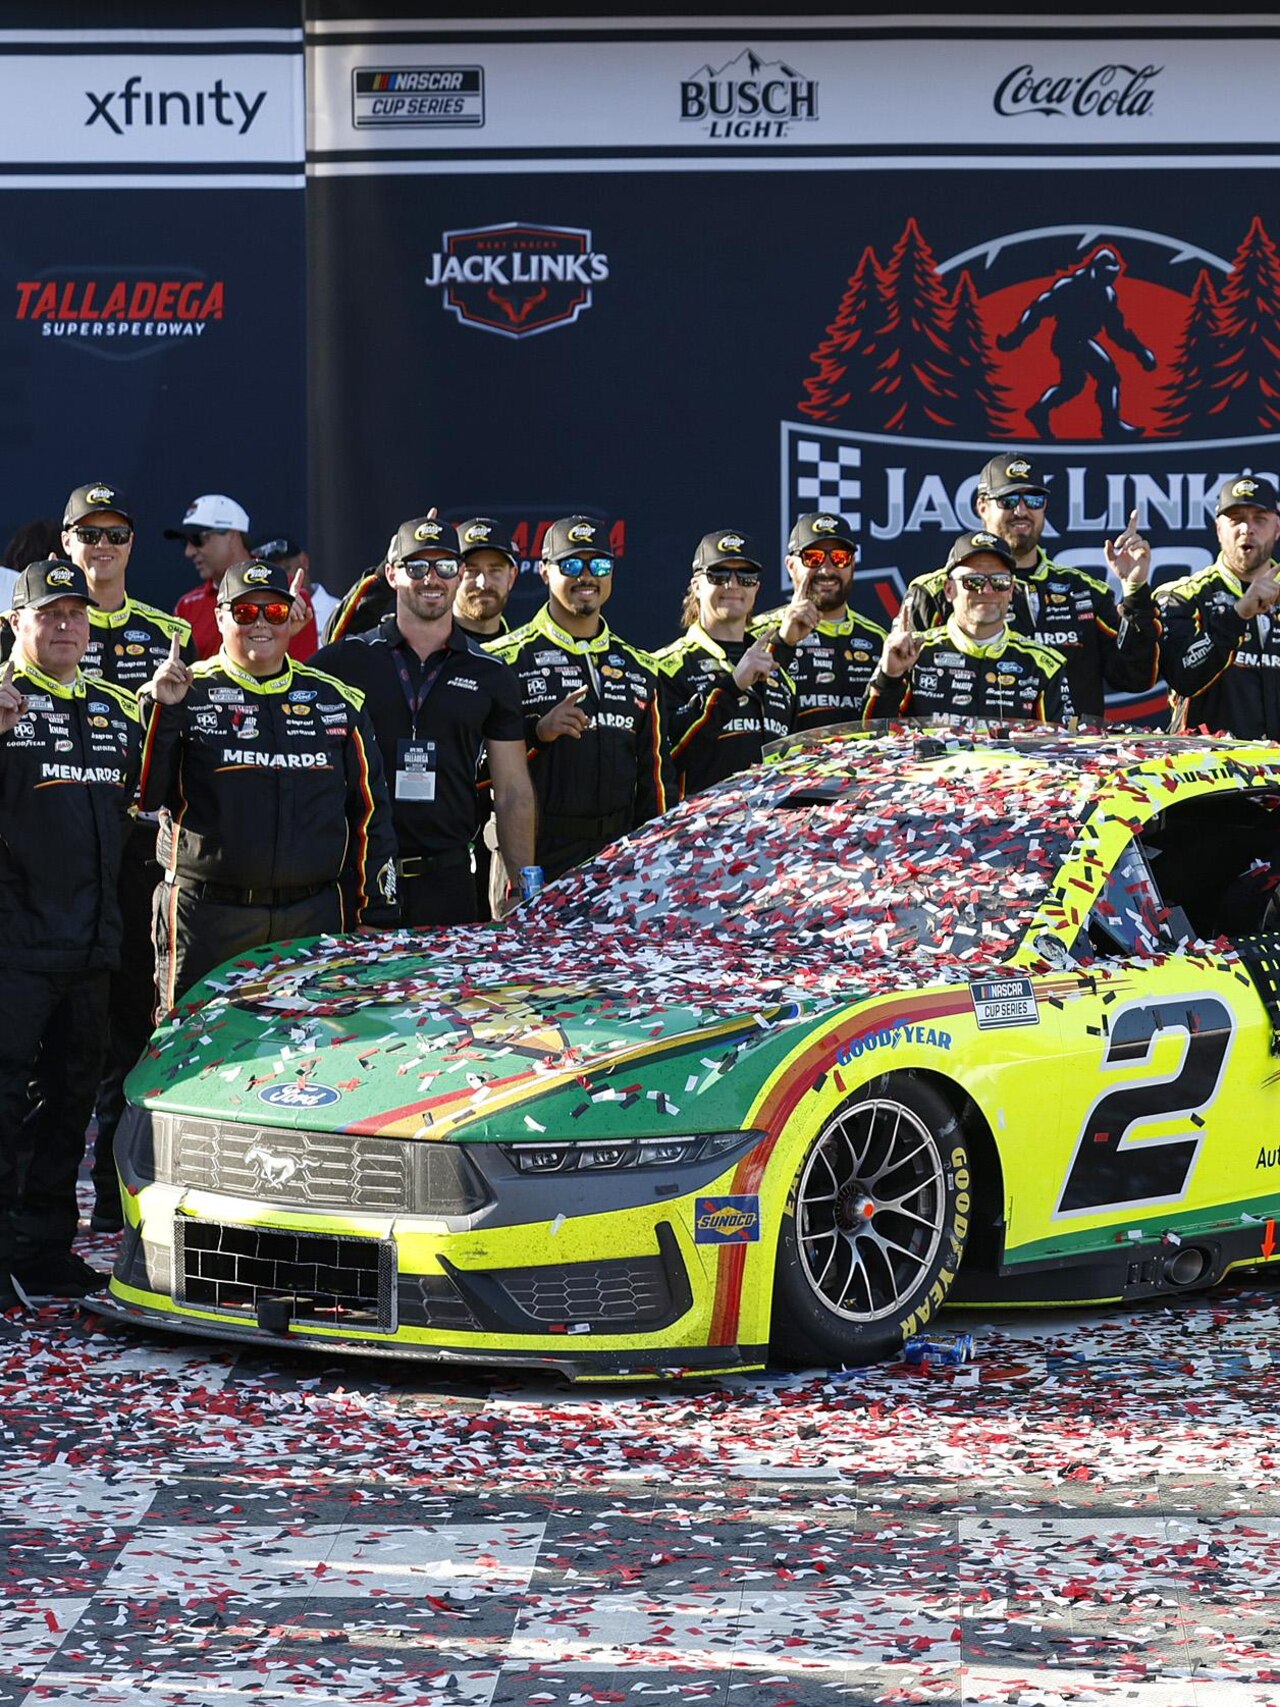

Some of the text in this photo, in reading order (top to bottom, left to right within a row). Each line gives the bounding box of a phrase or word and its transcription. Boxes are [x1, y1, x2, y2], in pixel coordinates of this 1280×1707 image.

[393, 71, 465, 91] NASCAR
[993, 63, 1165, 118] Coca-Cola
[85, 76, 267, 135] xfinity
[372, 97, 464, 115] CUP SERIES
[679, 79, 819, 121] BUSCH
[710, 121, 788, 139] LIGHT
[424, 252, 610, 286] JACK LINK'S
[16, 280, 224, 320] TALLADEGA
[42, 322, 206, 337] SUPERSPEEDWAY
[800, 693, 863, 708] MENAR
[6, 739, 46, 748] GOODYEAR
[223, 749, 328, 768] MENARDS
[42, 762, 120, 782] MENARDS
[991, 982, 1024, 998] NASCAR
[984, 1002, 1028, 1018] CUP SERIES
[836, 1022, 952, 1068] GOODYEAR
[271, 1084, 322, 1106] Ford
[1050, 991, 1237, 1222] 2
[698, 1212, 757, 1231] SUNOCO
[901, 1146, 973, 1339] GOODYEAR
